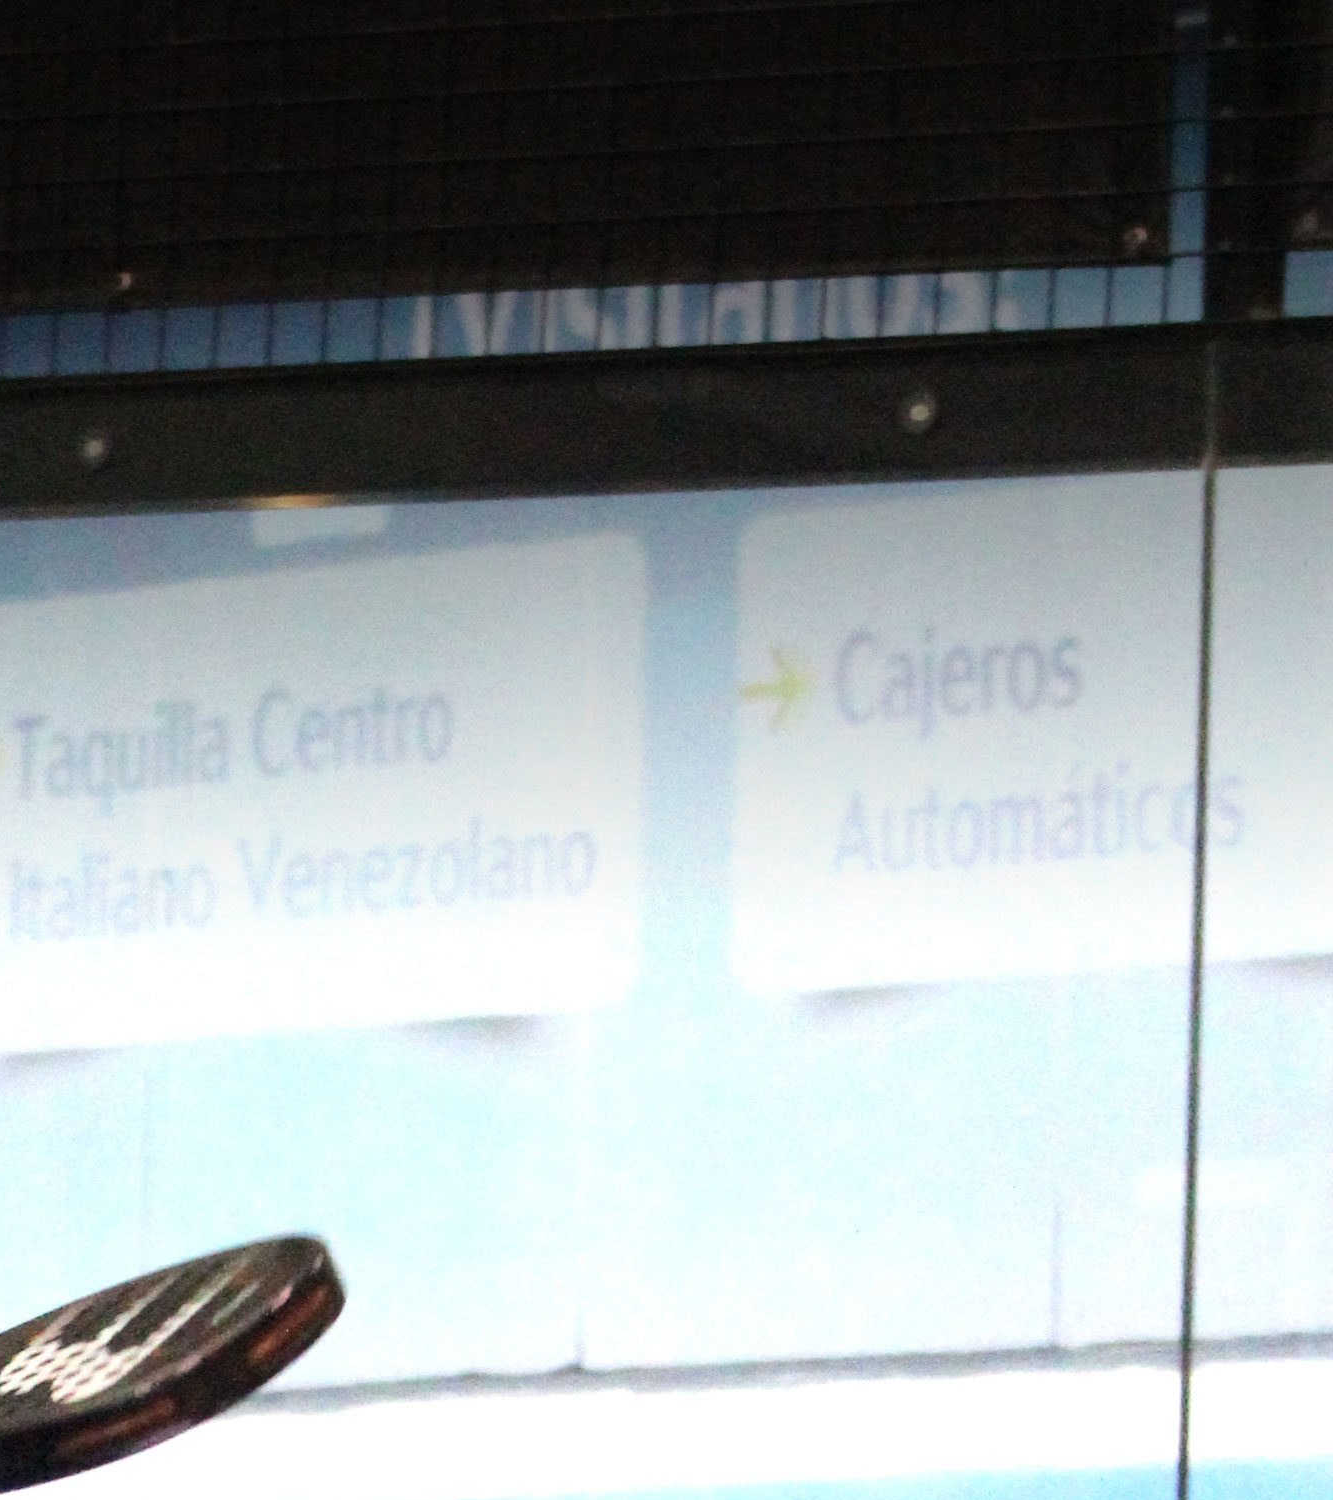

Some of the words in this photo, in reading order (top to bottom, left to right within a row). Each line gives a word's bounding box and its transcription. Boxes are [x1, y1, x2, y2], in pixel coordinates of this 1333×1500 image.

[837, 626, 1085, 741] Cajeros
[10, 698, 230, 820] Taquilla
[250, 685, 455, 778] Centro
[7, 847, 216, 944] Italiano
[233, 814, 599, 920] Venezolano
